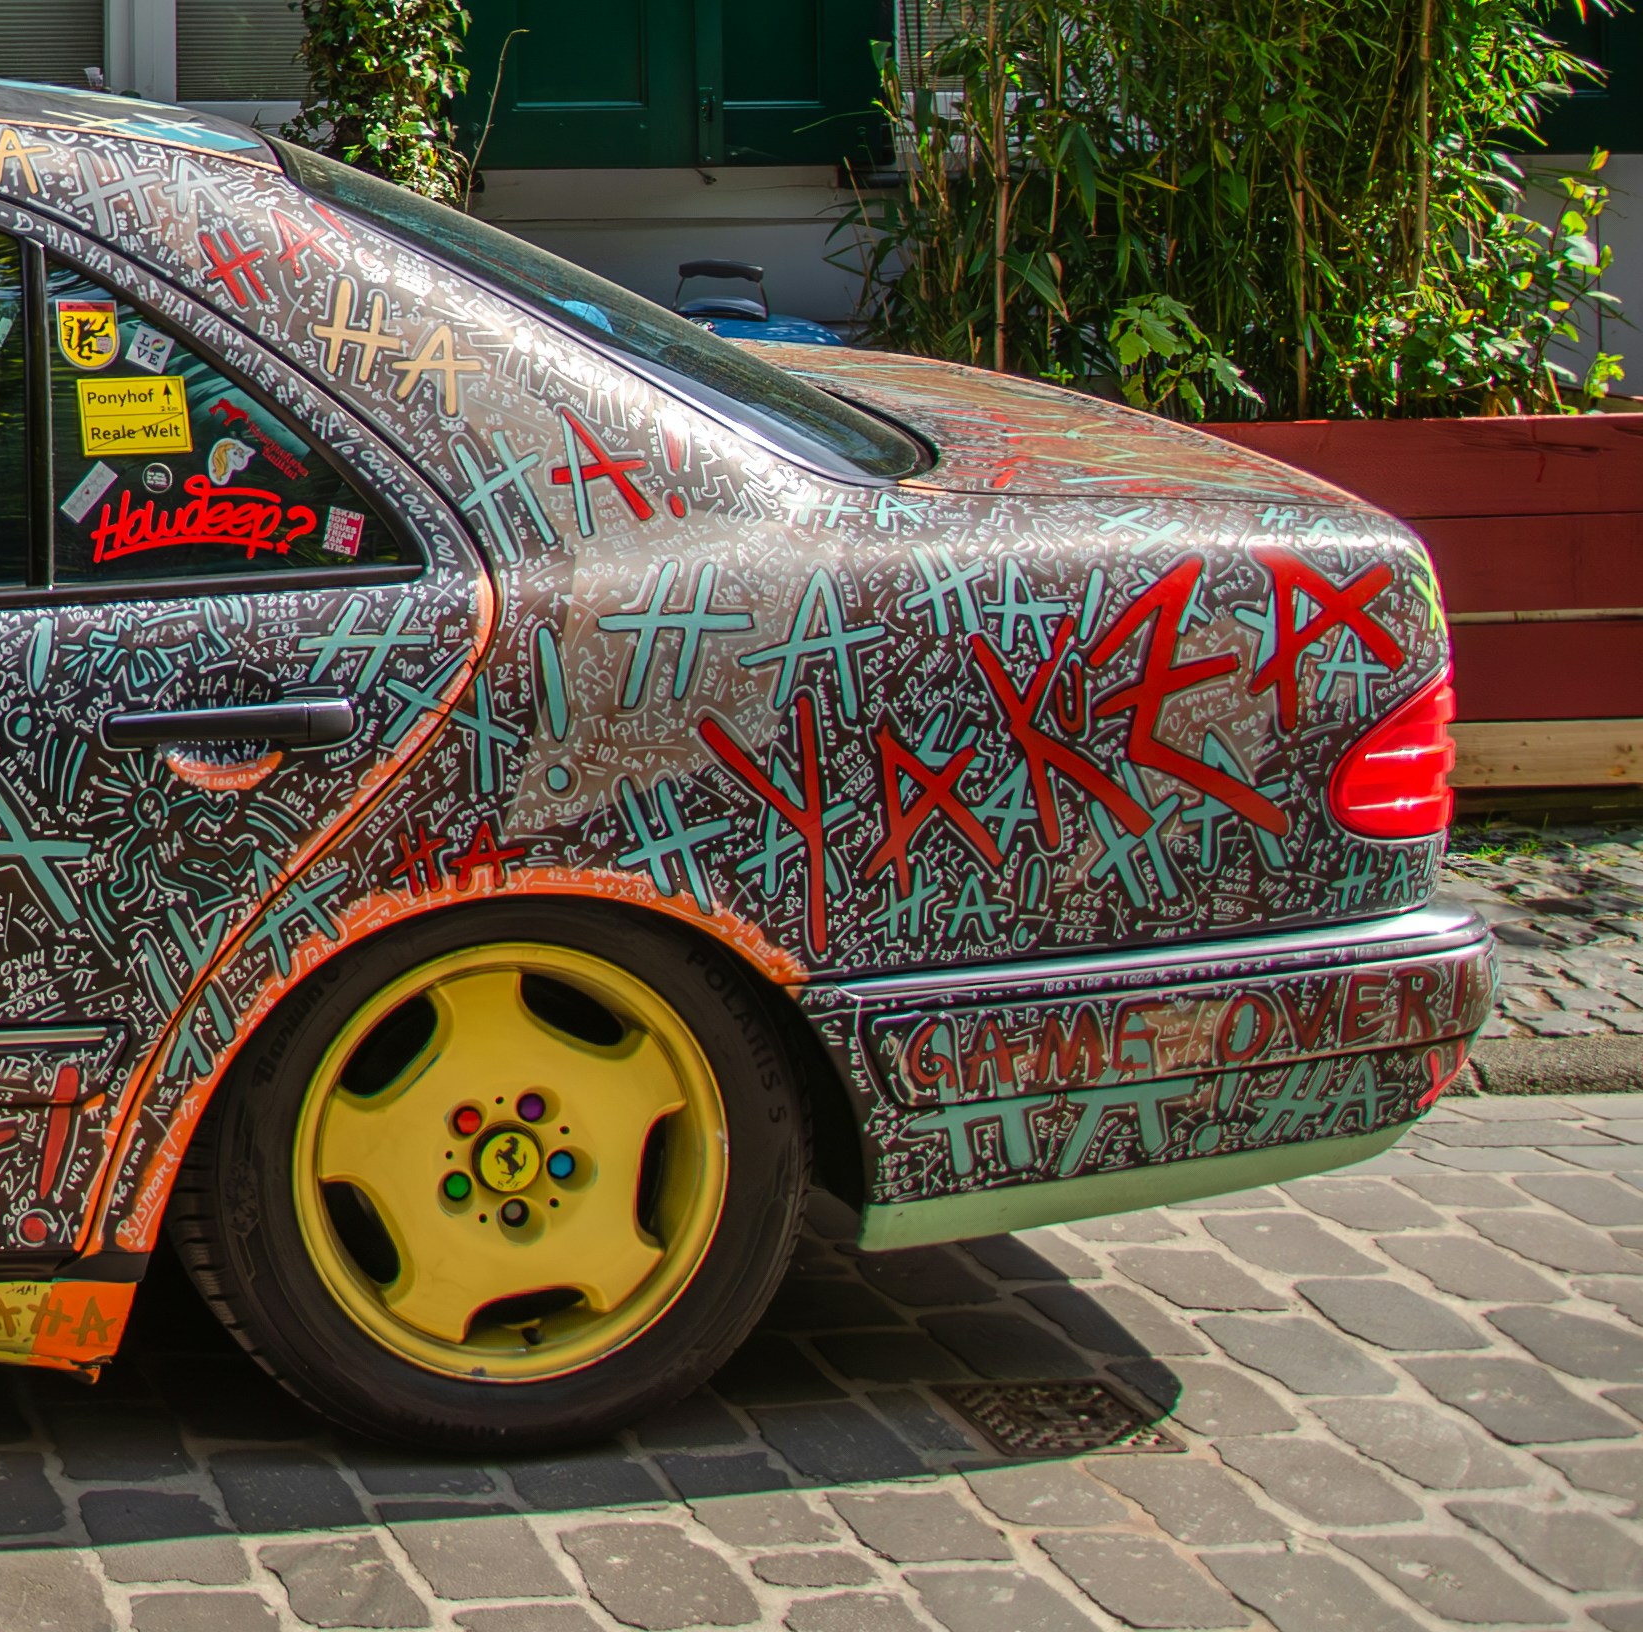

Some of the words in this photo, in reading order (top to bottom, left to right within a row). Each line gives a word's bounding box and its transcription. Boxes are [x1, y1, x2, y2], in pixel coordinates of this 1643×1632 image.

[72, 147, 232, 237] HA
[314, 279, 482, 416] HA
[88, 388, 154, 408] Ponyhof
[91, 425, 136, 441] Reale
[142, 424, 181, 438] Welt
[598, 560, 886, 721] HA
[586, 712, 674, 745] Tirpitz
[390, 820, 525, 896] HA
[909, 1003, 1165, 1089] GAME
